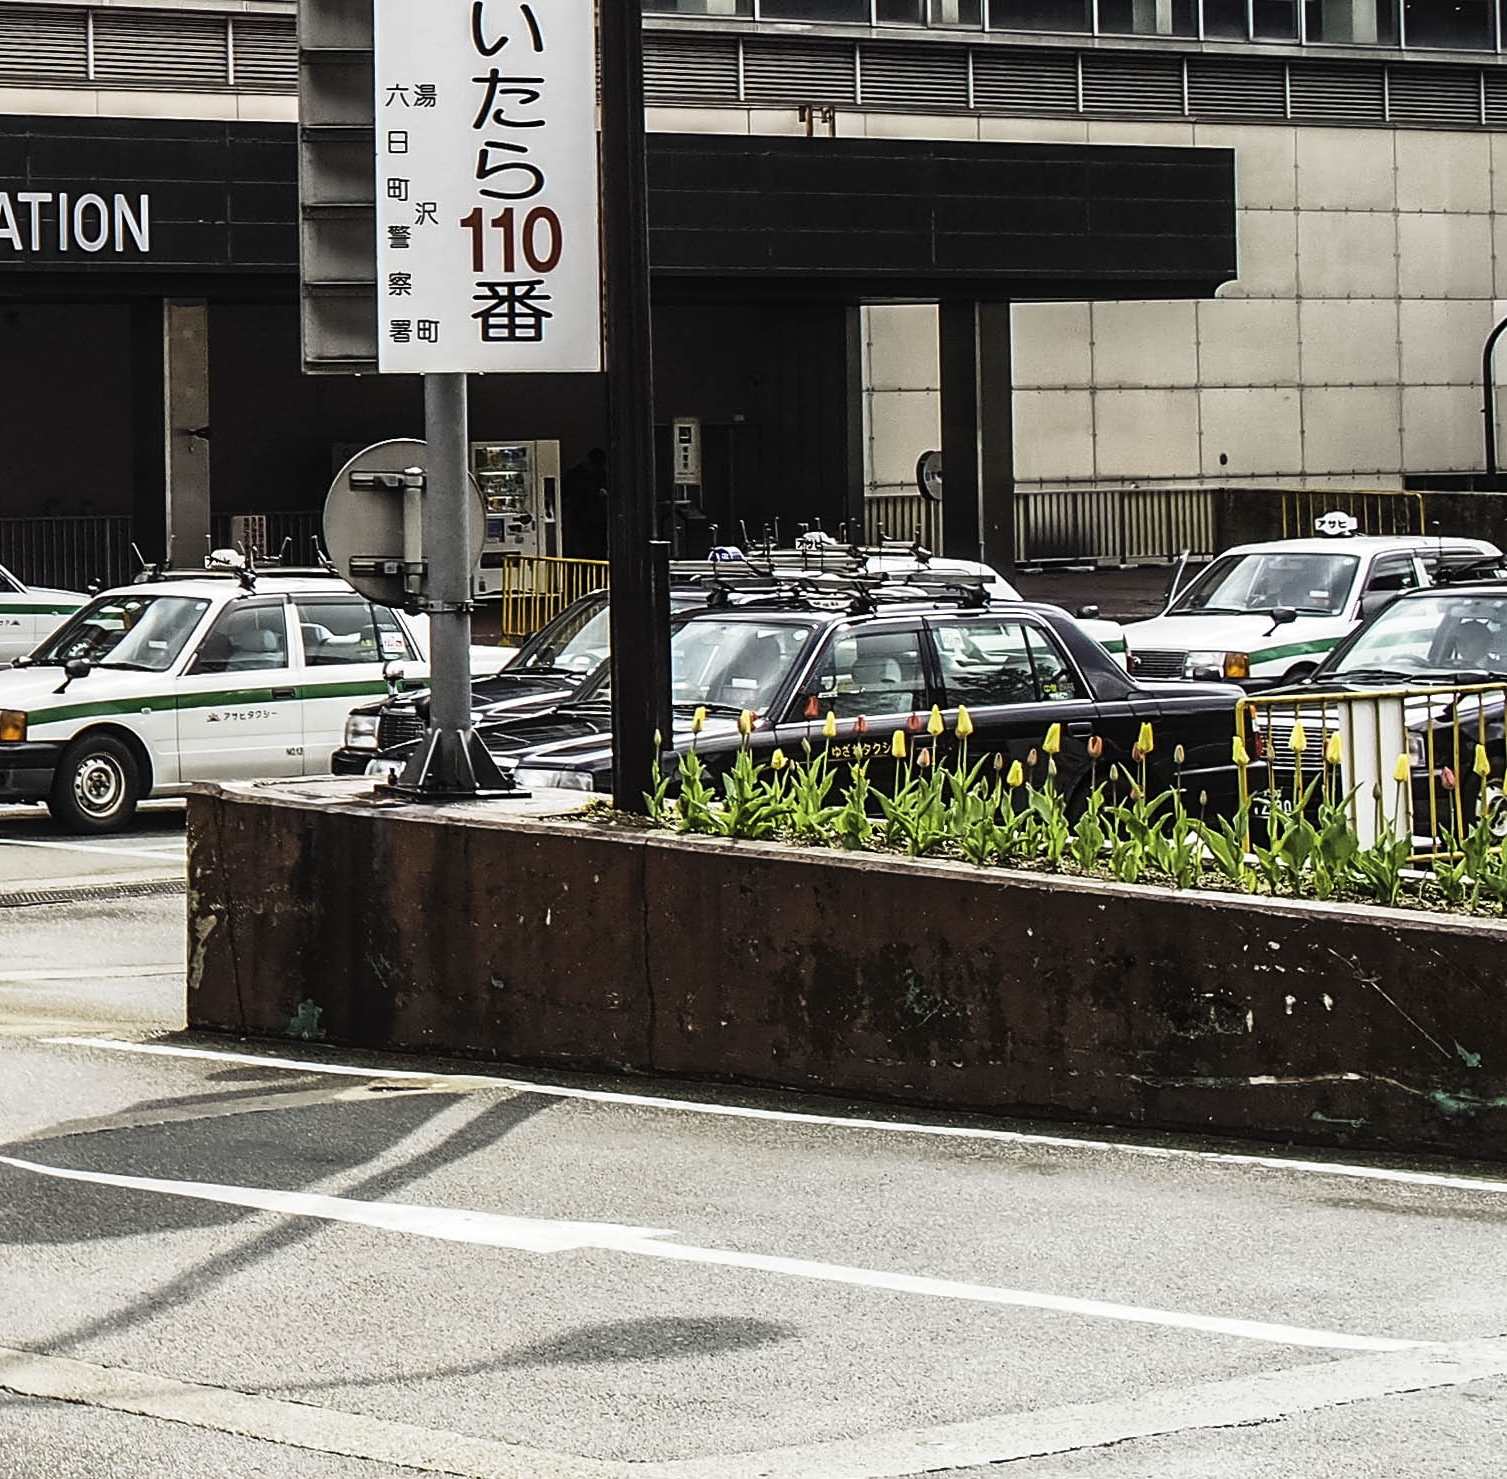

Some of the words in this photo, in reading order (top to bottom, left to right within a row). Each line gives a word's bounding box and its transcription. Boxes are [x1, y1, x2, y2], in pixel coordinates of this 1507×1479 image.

[385, 83, 413, 343] 六日町警察署
[1318, 520, 1347, 529] アサヒ
[223, 710, 278, 720] アサヒタクシー
